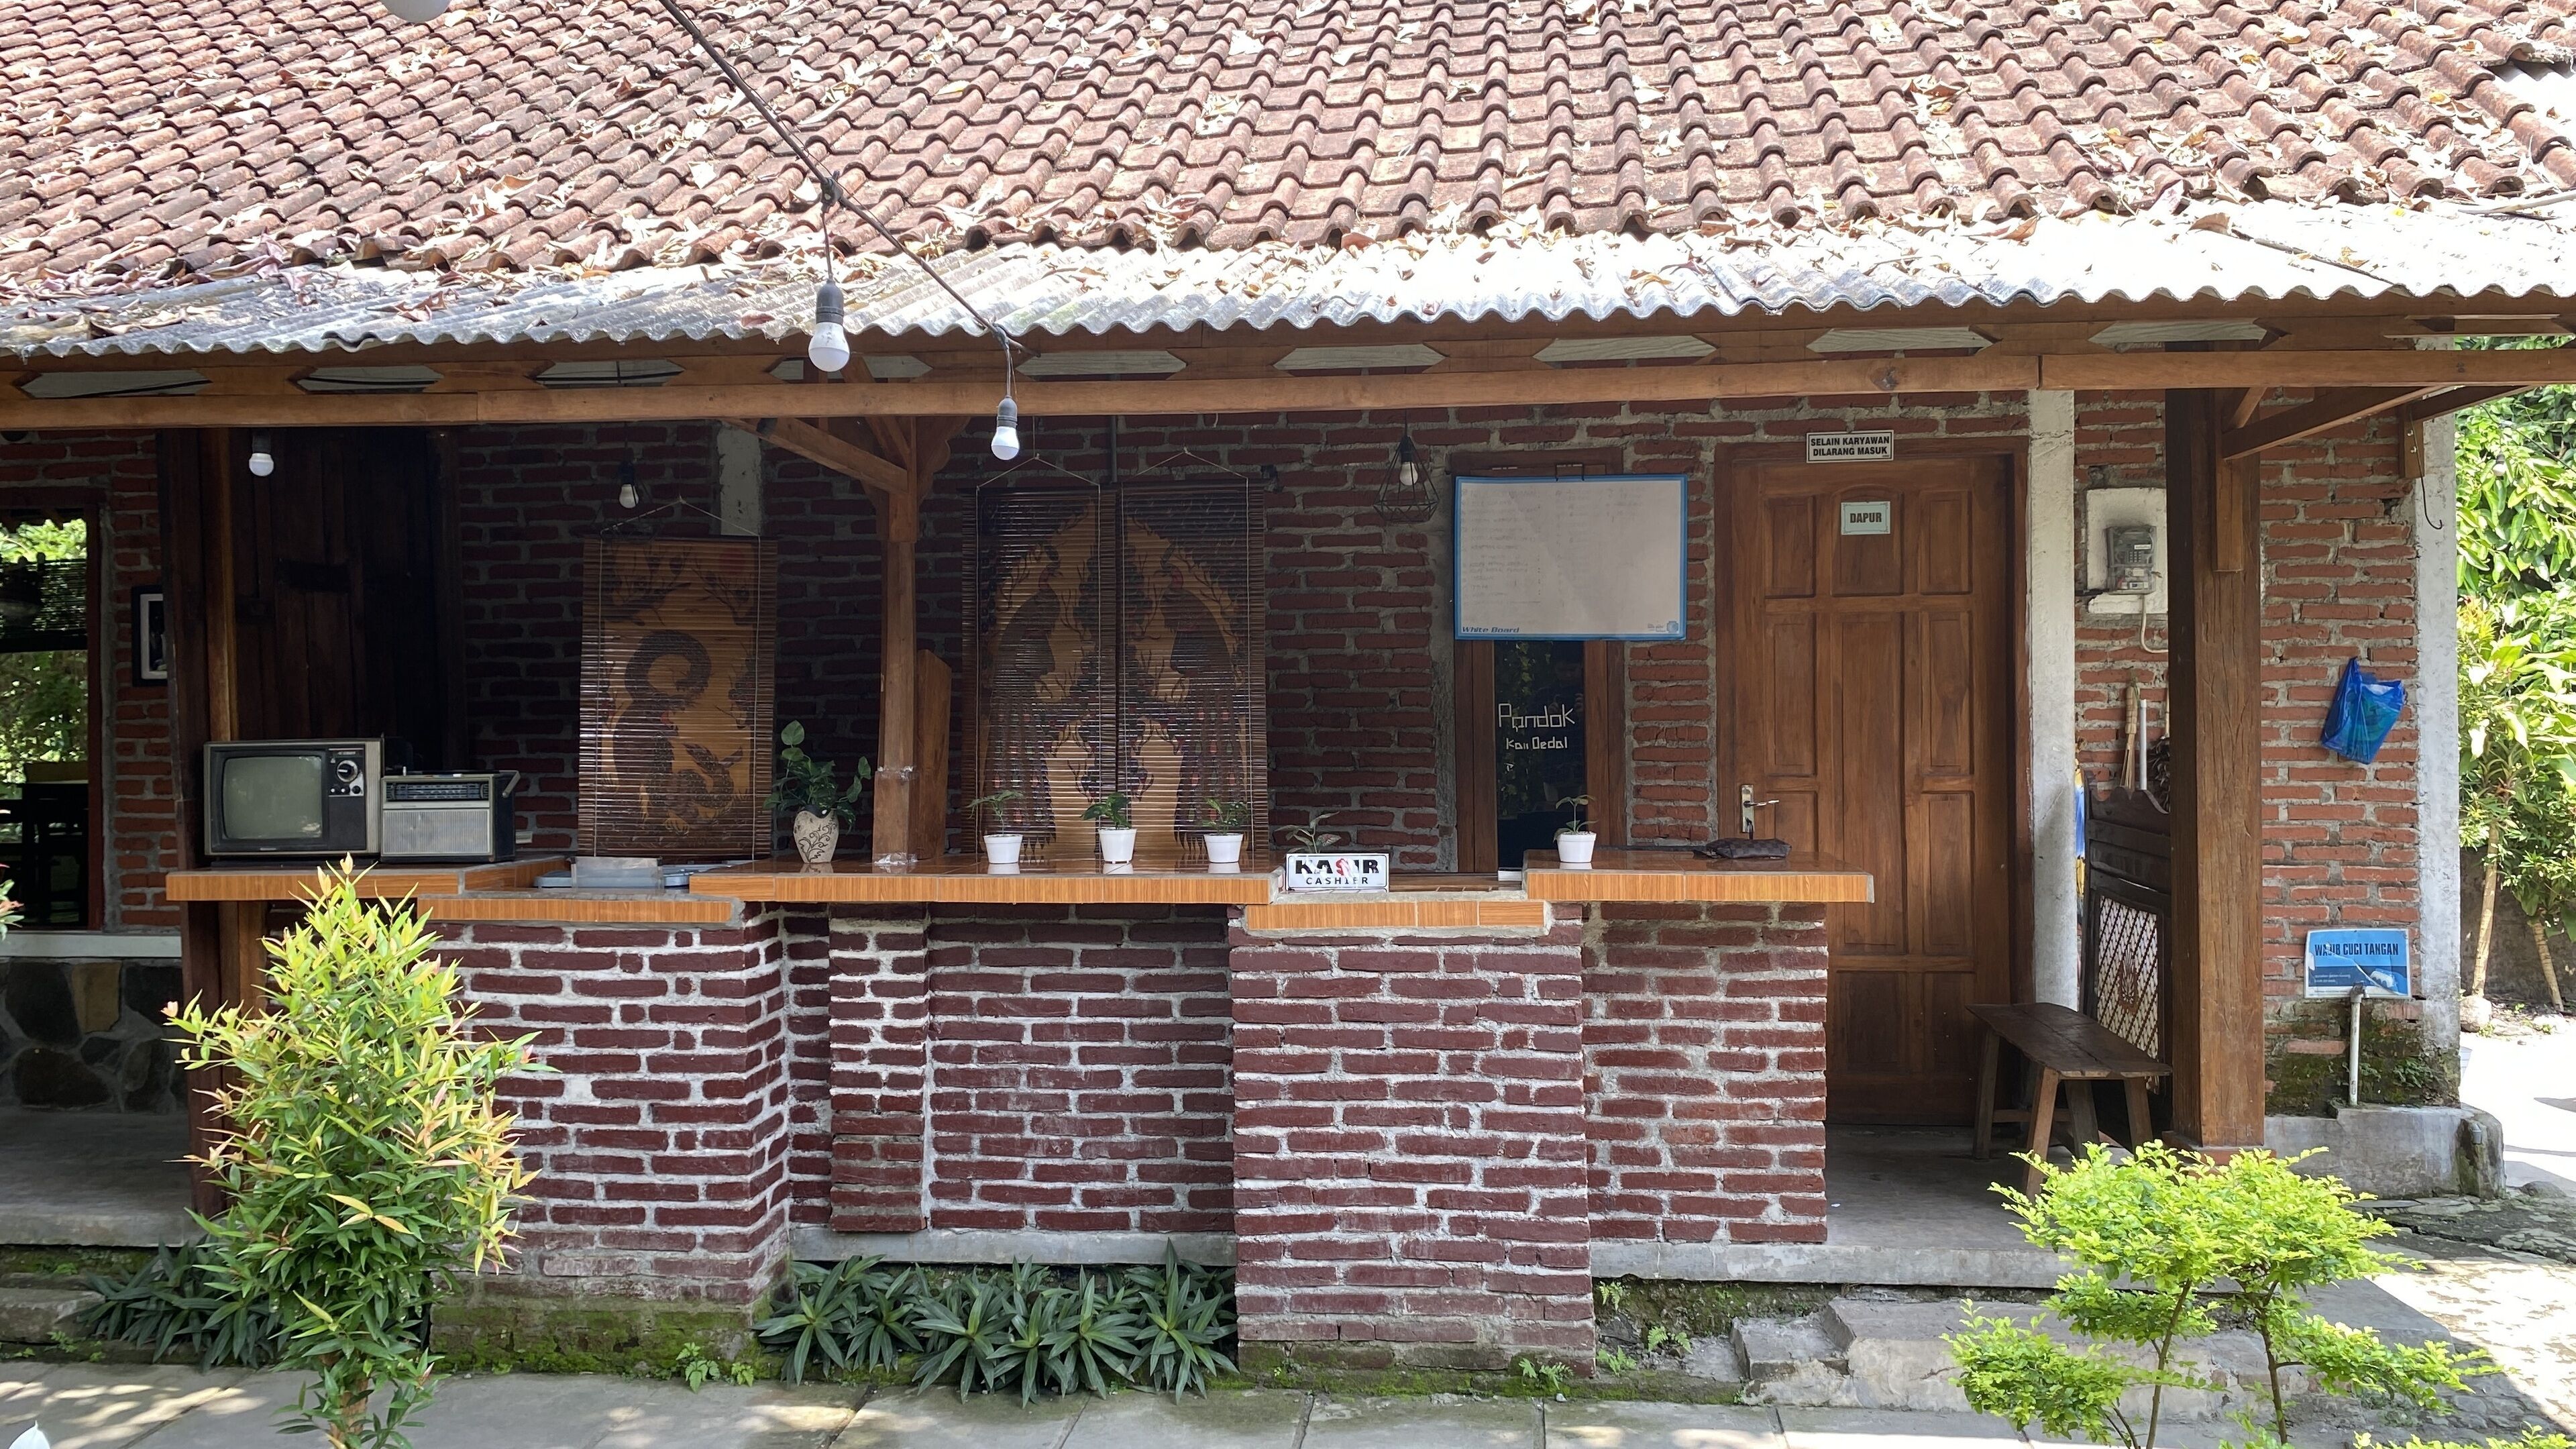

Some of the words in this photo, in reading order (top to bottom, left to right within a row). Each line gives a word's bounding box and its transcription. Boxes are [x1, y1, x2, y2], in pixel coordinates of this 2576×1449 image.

[1811, 437, 1840, 446] SELAIN
[1843, 436, 1890, 445] KARYAWAN
[1813, 447, 1855, 456] DILARANG
[1857, 446, 1887, 455] MASUK
[1849, 513, 1882, 523] DAPUR
[2343, 943, 2362, 955] CUCI
[2365, 943, 2399, 955] TANGAN
